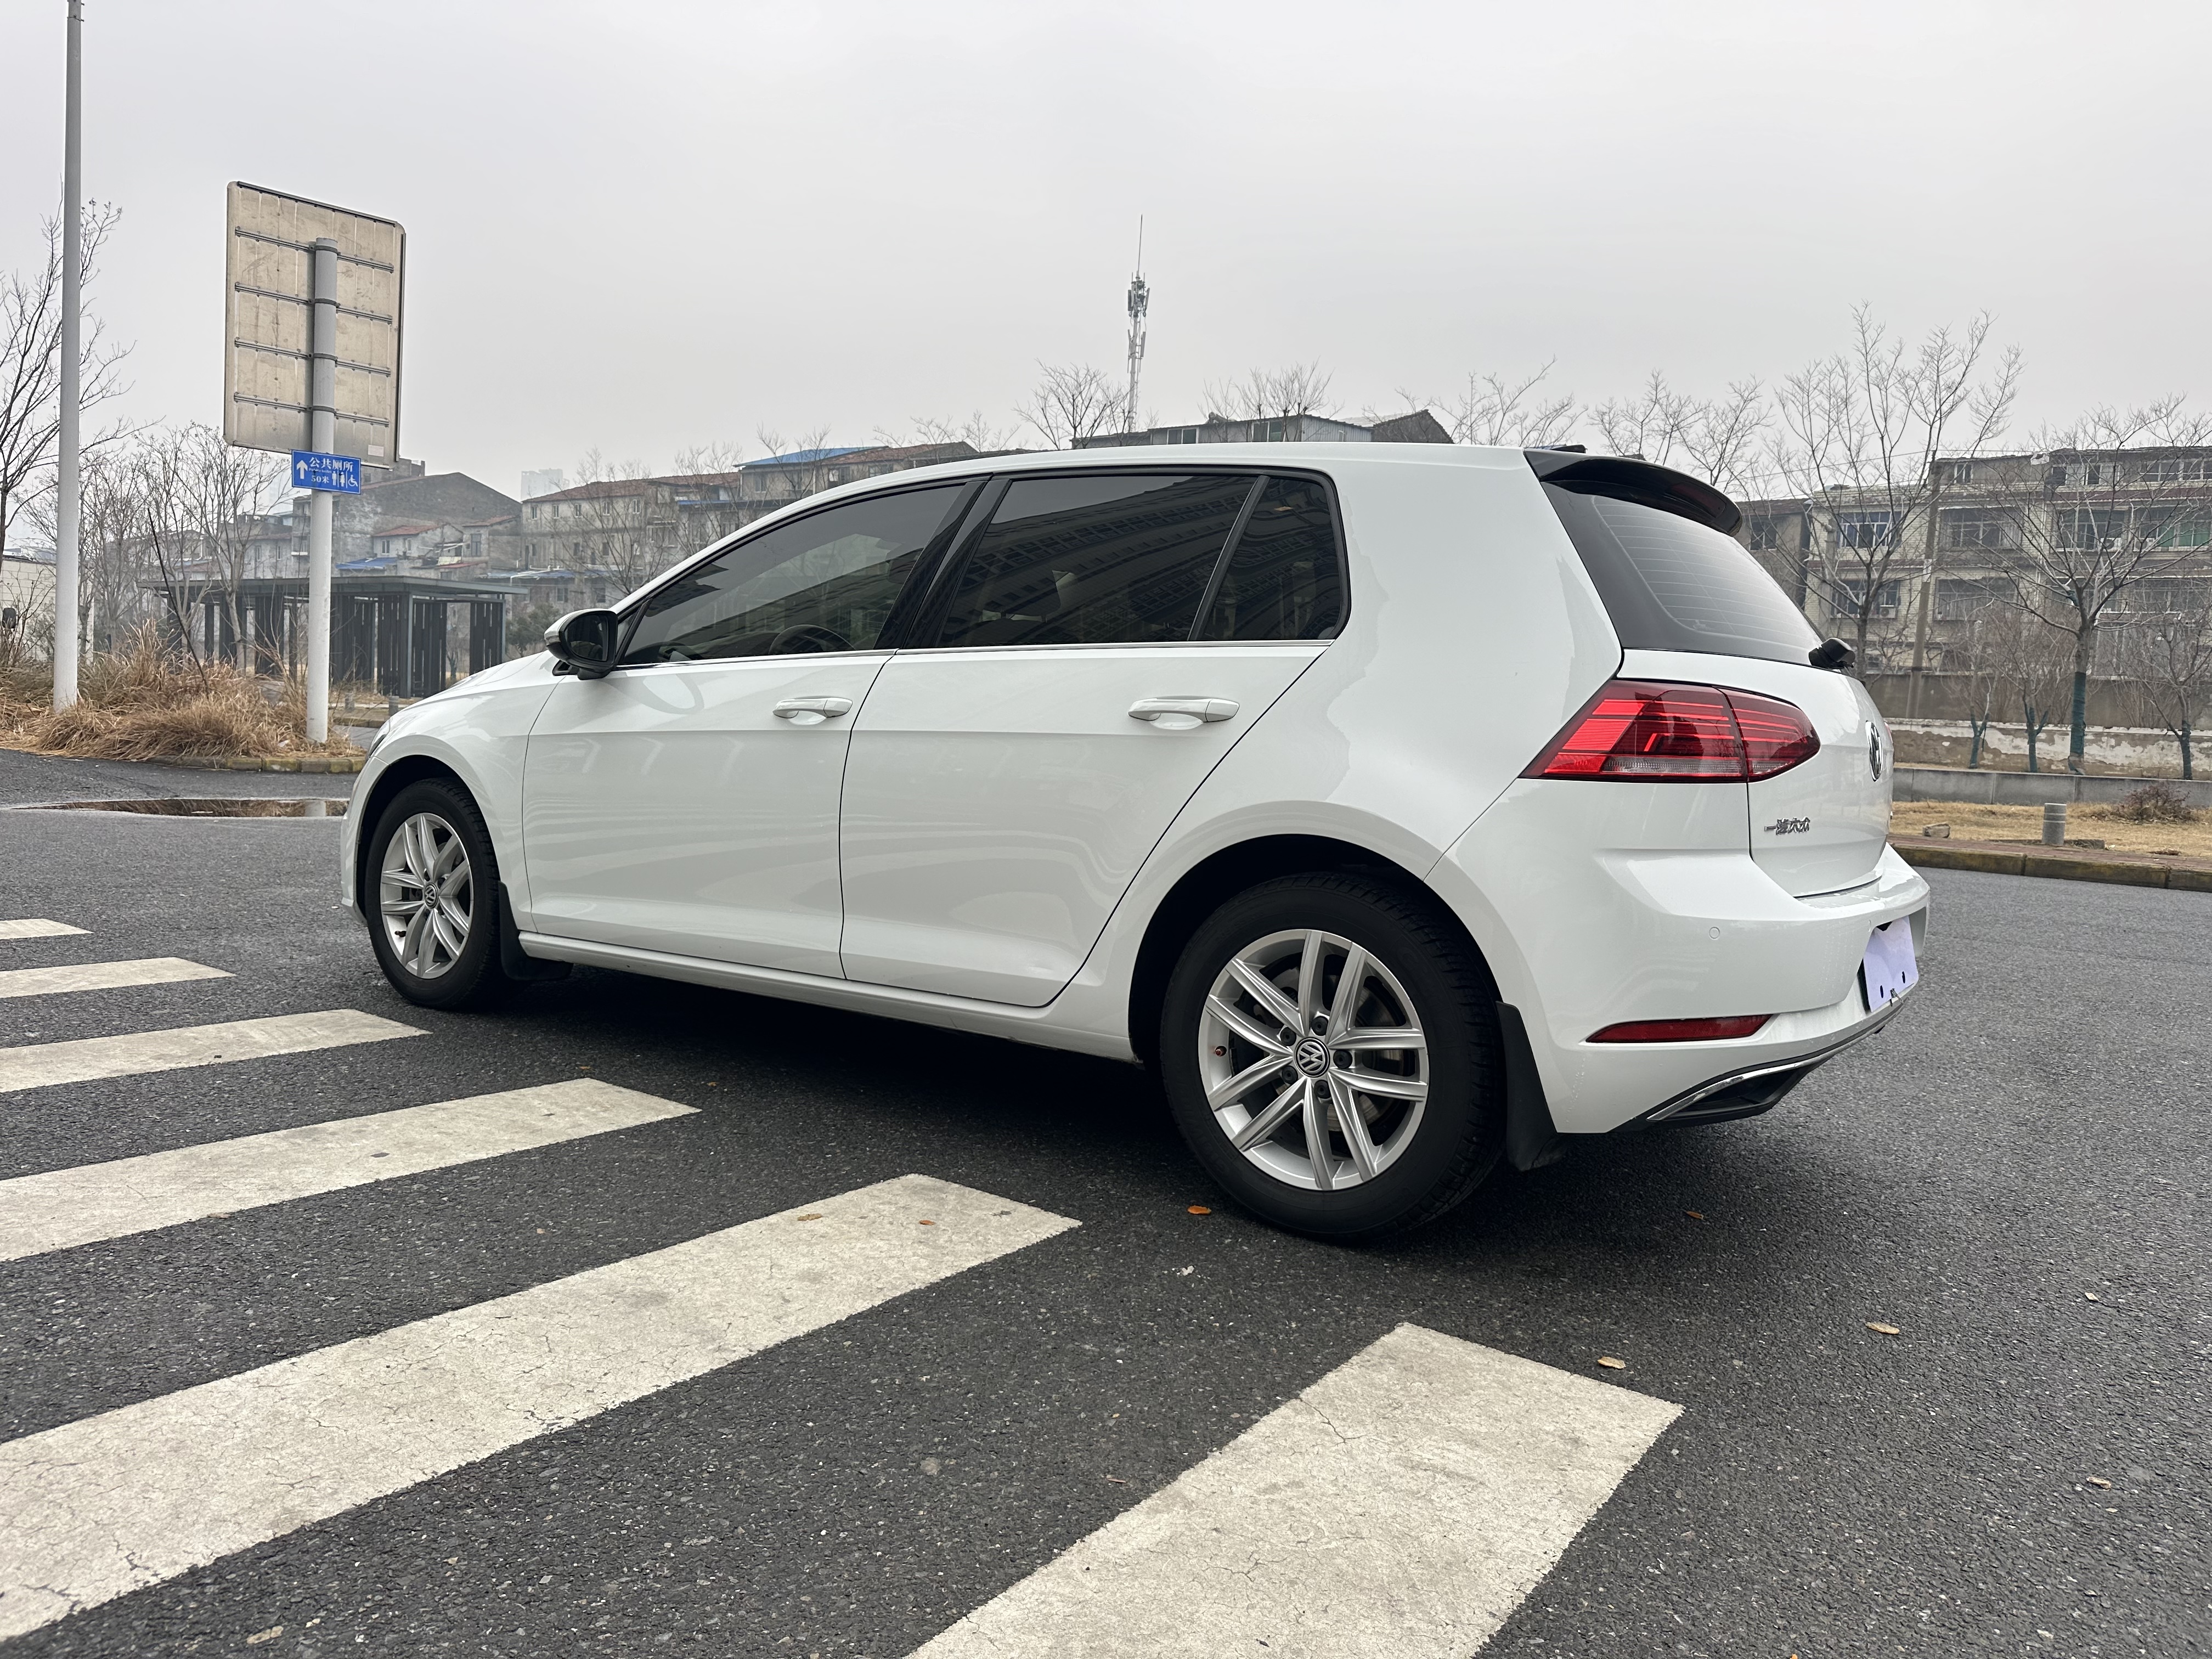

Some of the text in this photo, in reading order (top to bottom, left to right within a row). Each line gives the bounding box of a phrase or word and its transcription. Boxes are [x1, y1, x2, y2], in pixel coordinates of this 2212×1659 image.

[309, 457, 353, 472] 公共厕所
[311, 475, 329, 484] 50米
[1296, 1041, 1327, 1074] VW
